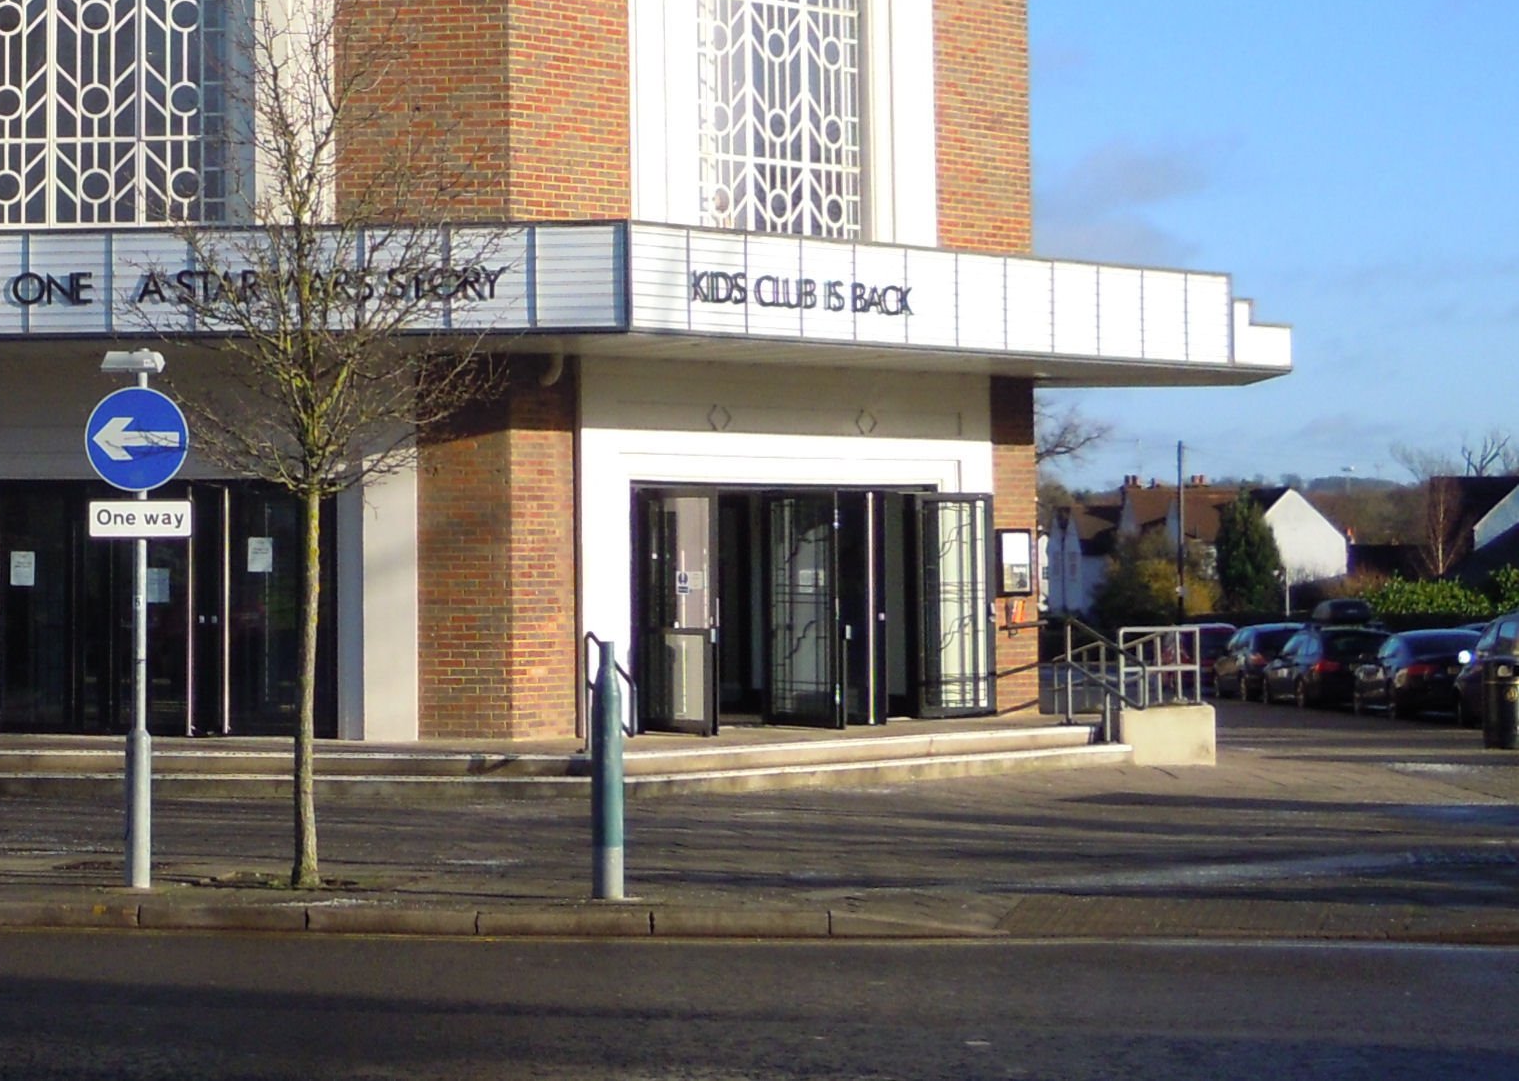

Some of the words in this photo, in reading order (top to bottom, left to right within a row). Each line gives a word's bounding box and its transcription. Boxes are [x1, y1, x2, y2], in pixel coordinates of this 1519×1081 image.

[12, 271, 93, 305] ONE
[137, 271, 166, 303] A
[177, 269, 261, 303] STAR
[388, 266, 506, 300] STORY
[691, 270, 747, 305] KIDS
[754, 275, 817, 310] CLUB
[824, 280, 845, 312] IS
[851, 282, 914, 316] BACK
[96, 509, 137, 525] One
[143, 512, 184, 529] way
